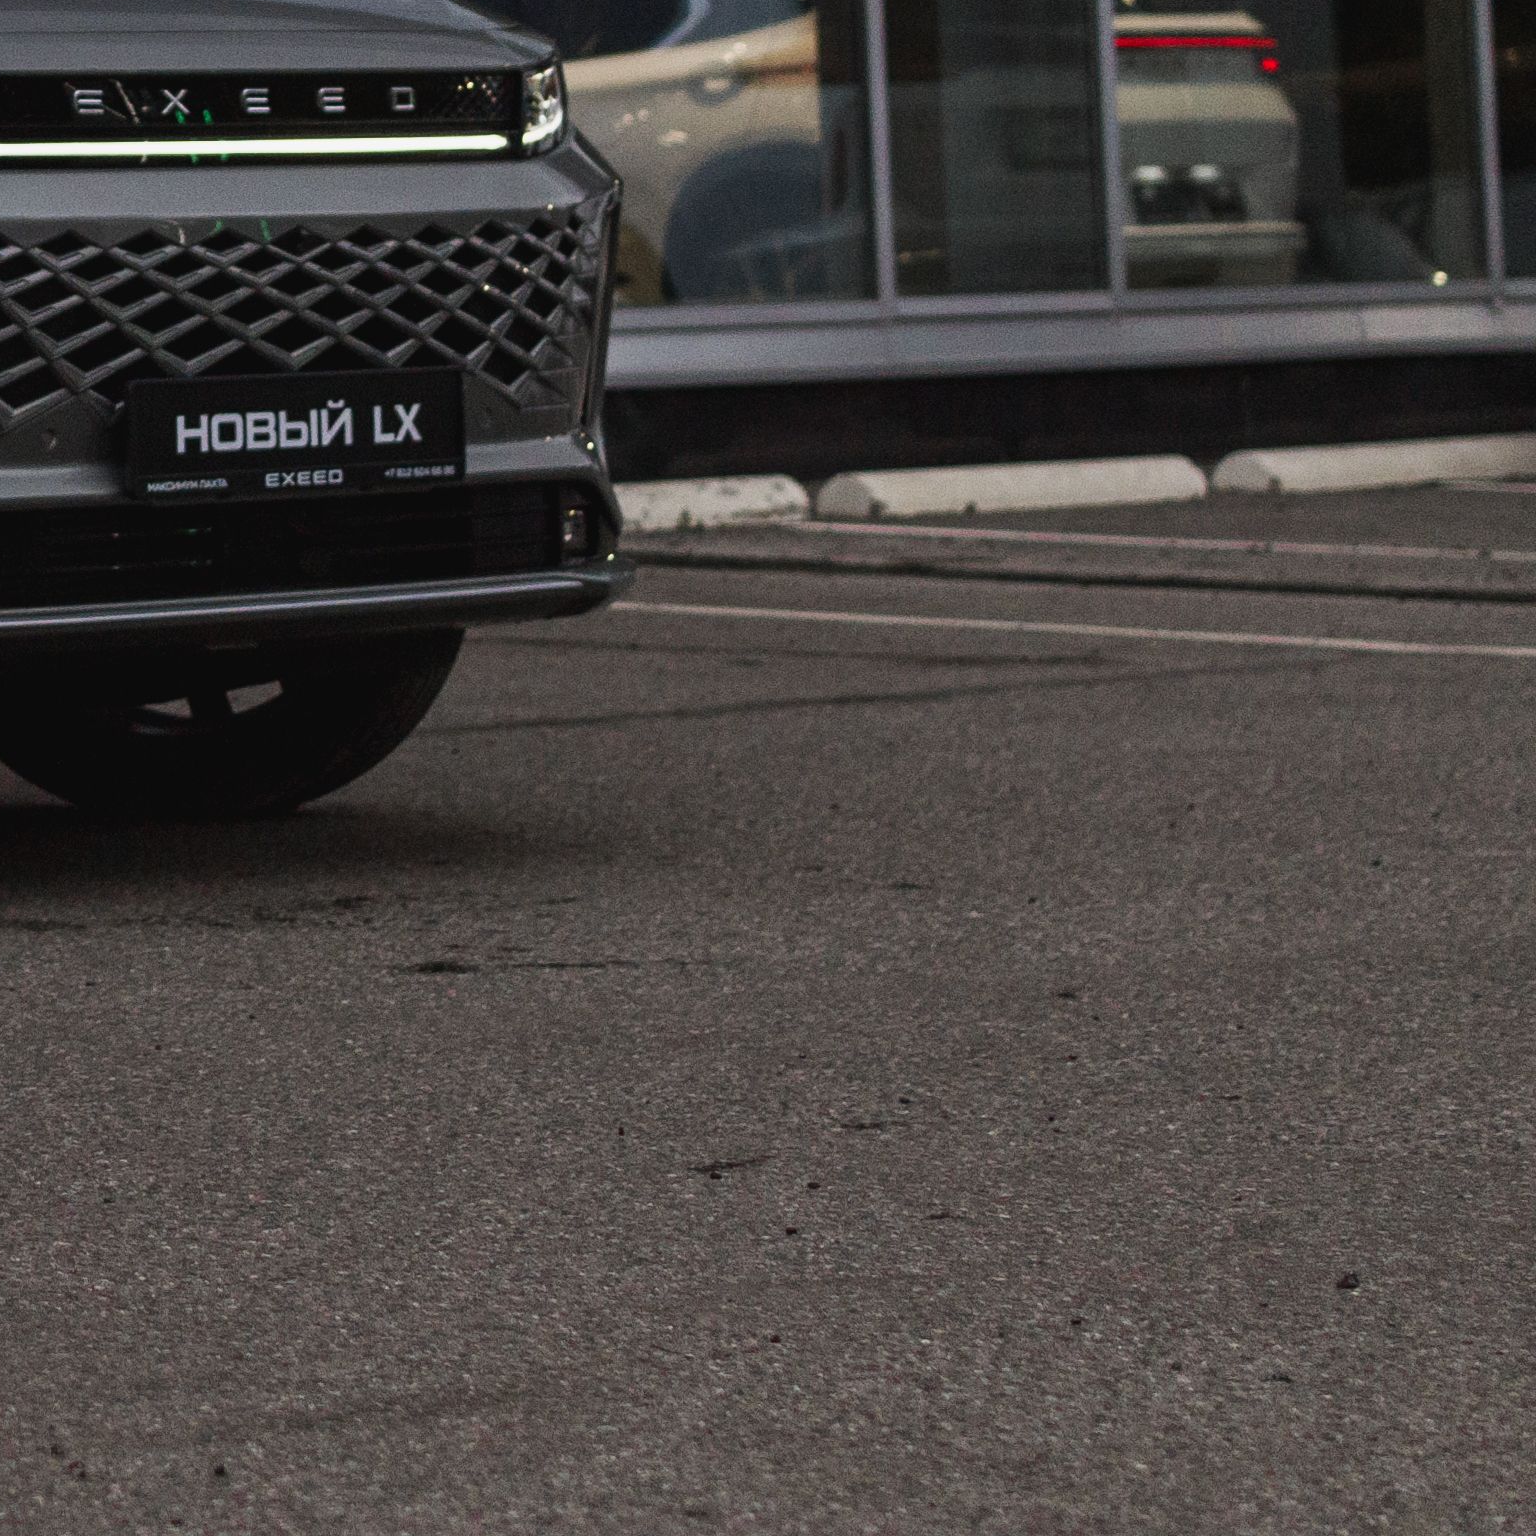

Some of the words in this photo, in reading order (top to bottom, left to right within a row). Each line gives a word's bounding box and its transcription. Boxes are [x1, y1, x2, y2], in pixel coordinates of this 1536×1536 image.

[72, 86, 416, 115] EXEED
[176, 399, 353, 454] НОВЫЙ
[373, 402, 423, 444] LX
[264, 468, 344, 489] EXEED
